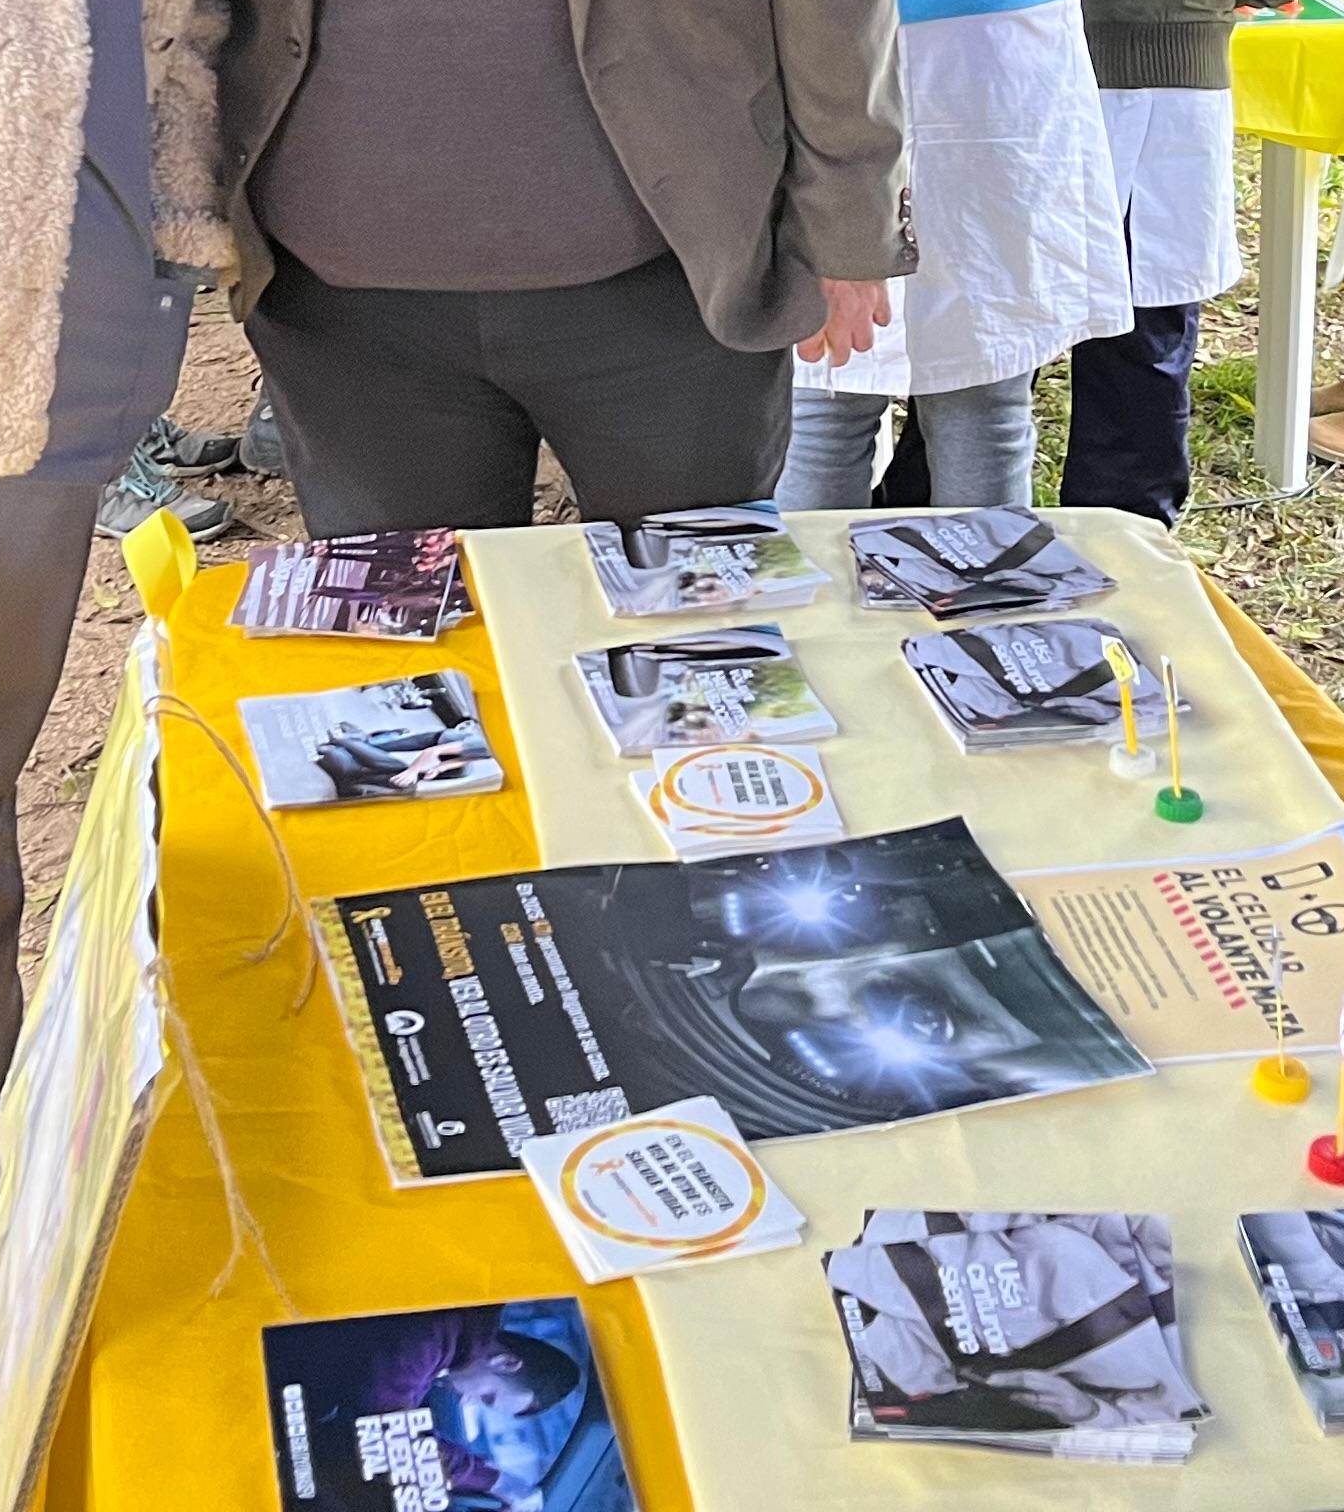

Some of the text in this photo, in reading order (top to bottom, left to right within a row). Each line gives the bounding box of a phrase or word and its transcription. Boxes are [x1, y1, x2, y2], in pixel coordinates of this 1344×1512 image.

[1172, 871, 1306, 1041] AL VOLANTE MATA
[1212, 867, 1306, 973] EL CELULAR
[937, 1265, 981, 1356] siempre
[354, 1414, 390, 1482] FATAL
[382, 1409, 417, 1488] PUEDE
[407, 1406, 453, 1512] EL SUEÑO
